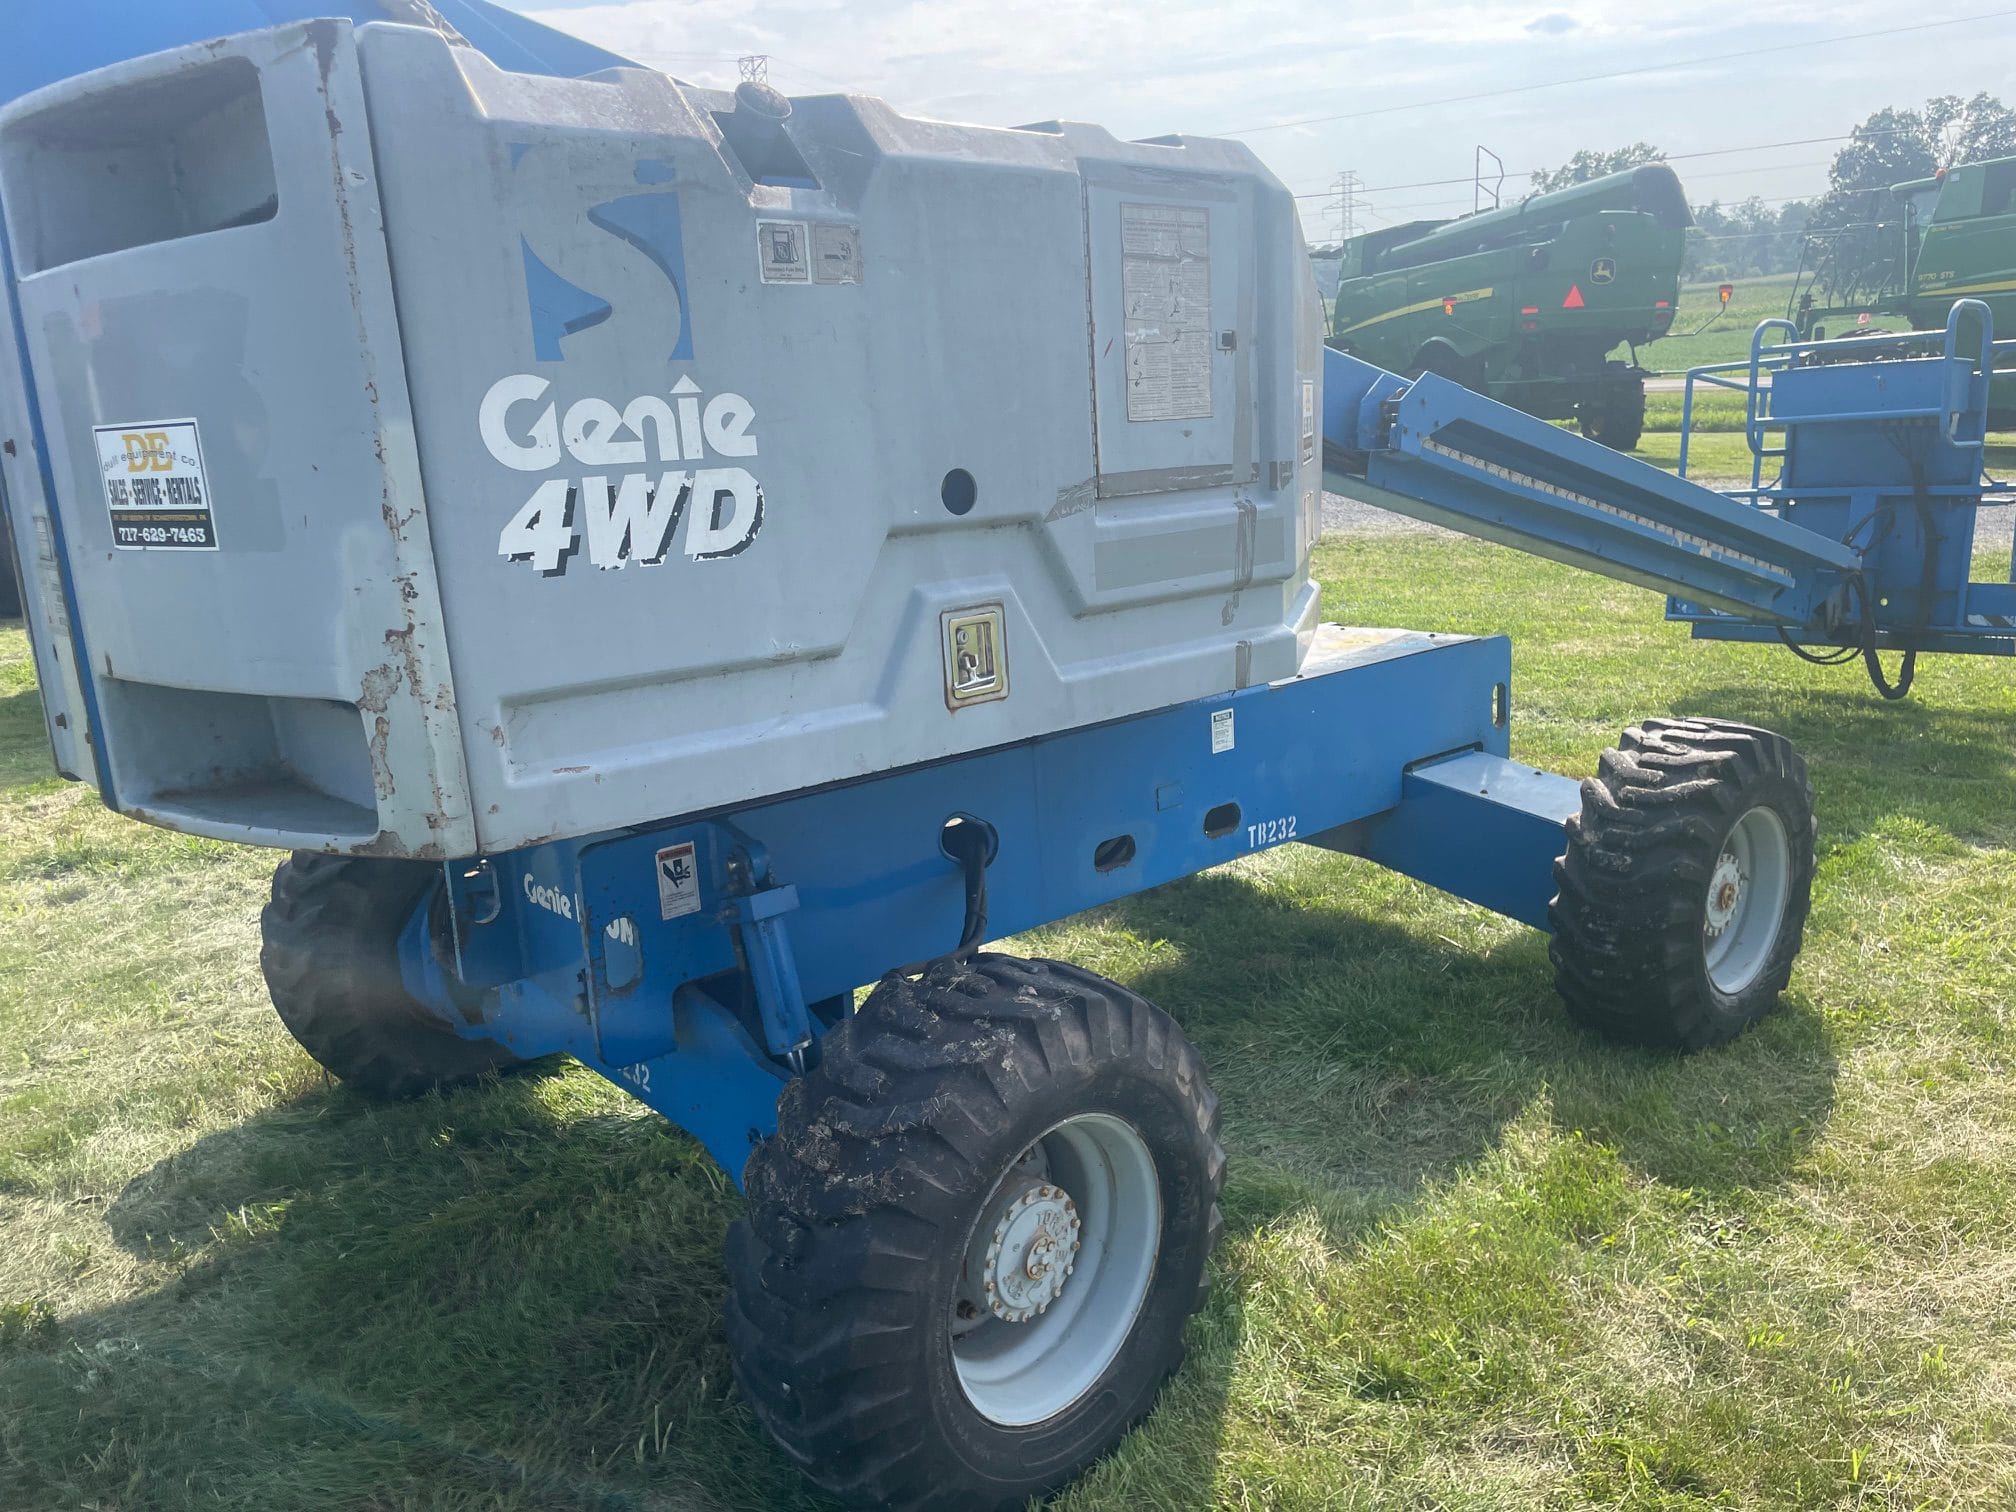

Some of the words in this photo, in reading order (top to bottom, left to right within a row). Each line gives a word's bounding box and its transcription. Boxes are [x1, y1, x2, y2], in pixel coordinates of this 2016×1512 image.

[479, 374, 758, 471] Genie
[121, 432, 173, 472] DE
[107, 478, 129, 505] SALES
[131, 477, 163, 505] SERVICE
[165, 476, 202, 505] RENTALS
[118, 527, 206, 543] 717-629-7463
[498, 467, 765, 577] 4WD
[523, 873, 572, 920] Genie
